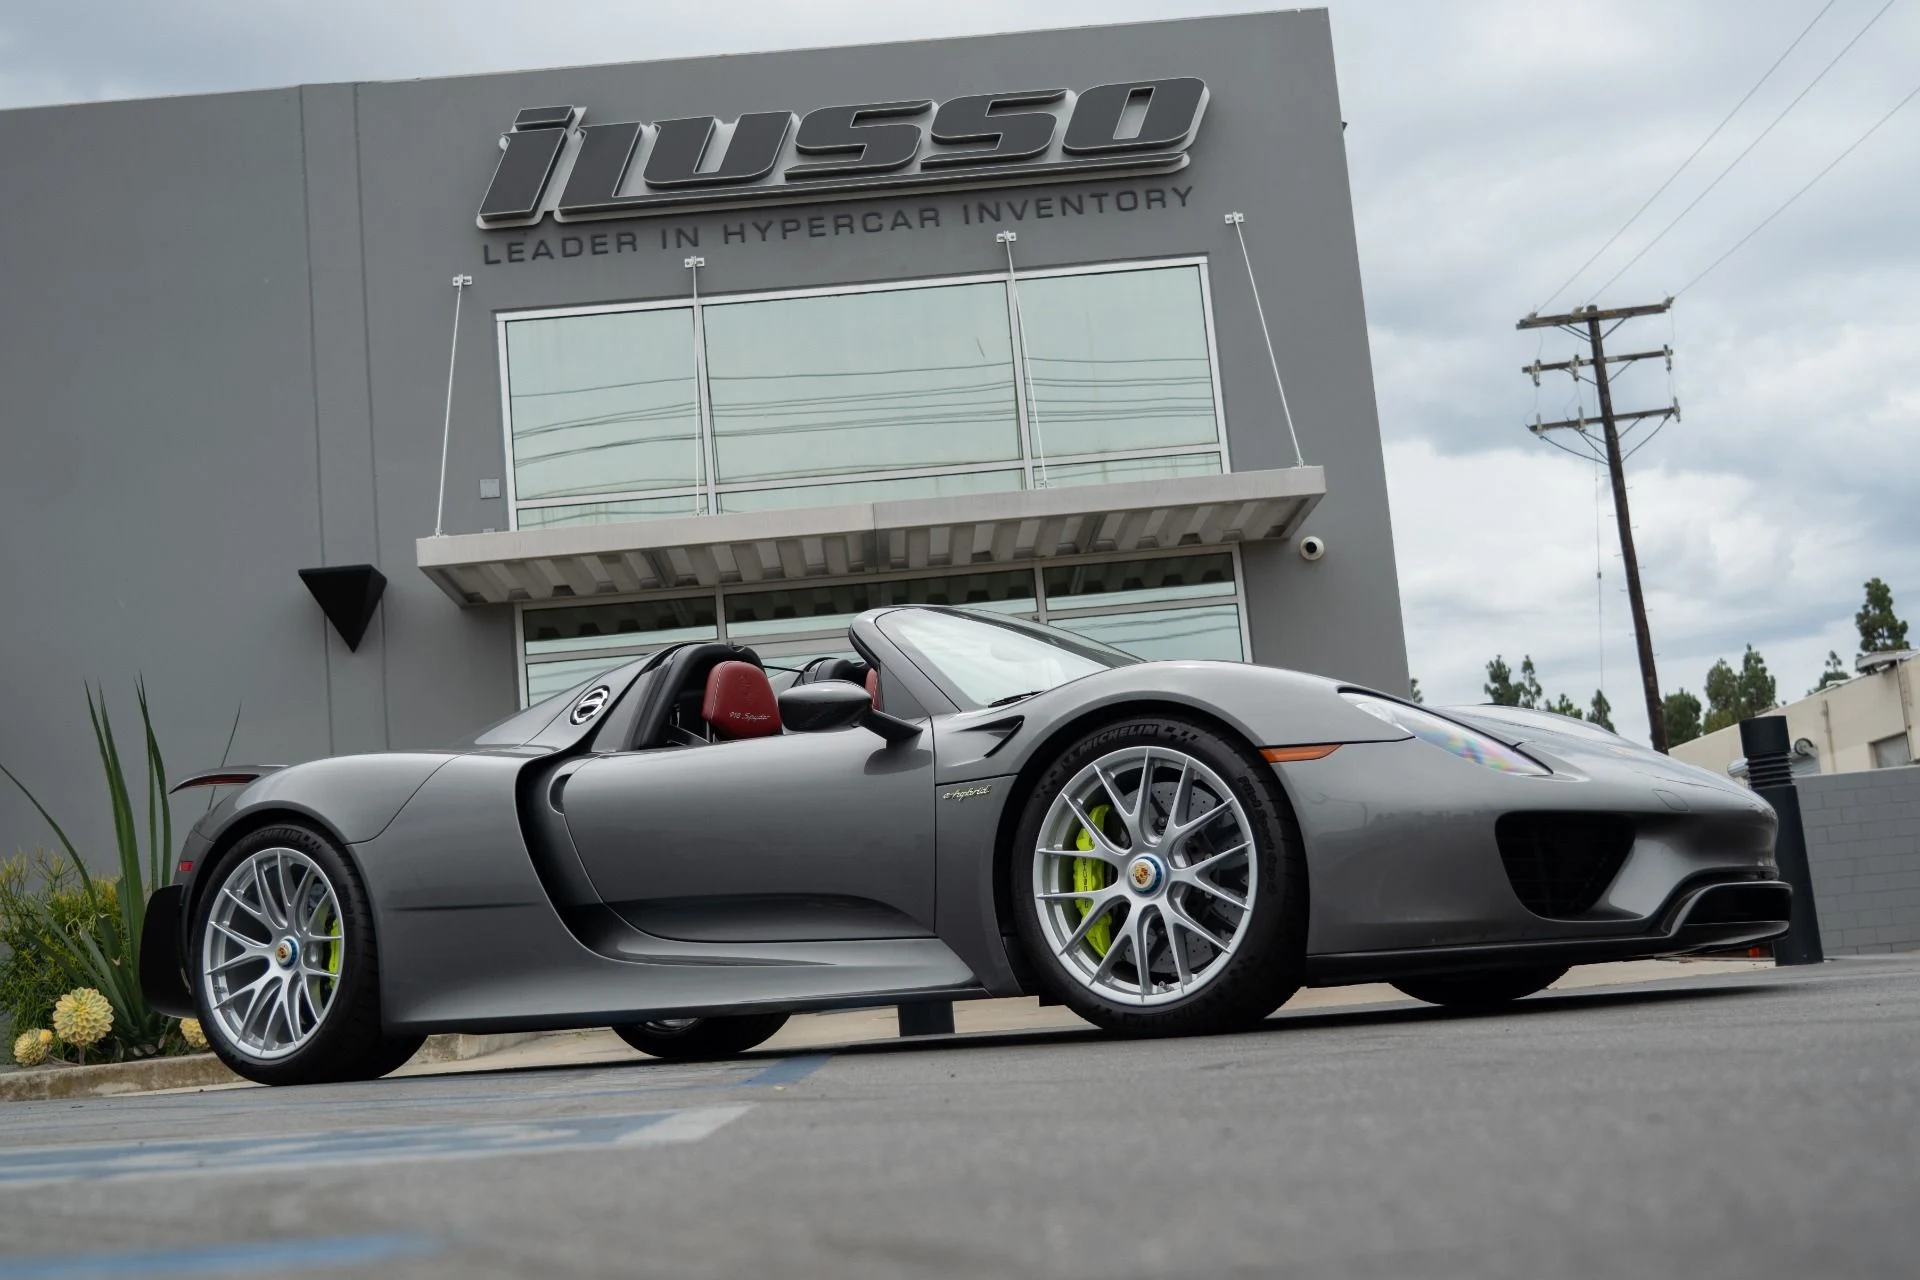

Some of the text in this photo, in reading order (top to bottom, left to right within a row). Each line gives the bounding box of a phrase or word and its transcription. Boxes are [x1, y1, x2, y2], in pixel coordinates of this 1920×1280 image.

[483, 185, 1193, 266] LEADER IN HYPERCAR INVENTORY
[729, 711, 741, 719] 918
[1079, 724, 1159, 756] MICHELIN
[943, 785, 992, 801] e-hybrid
